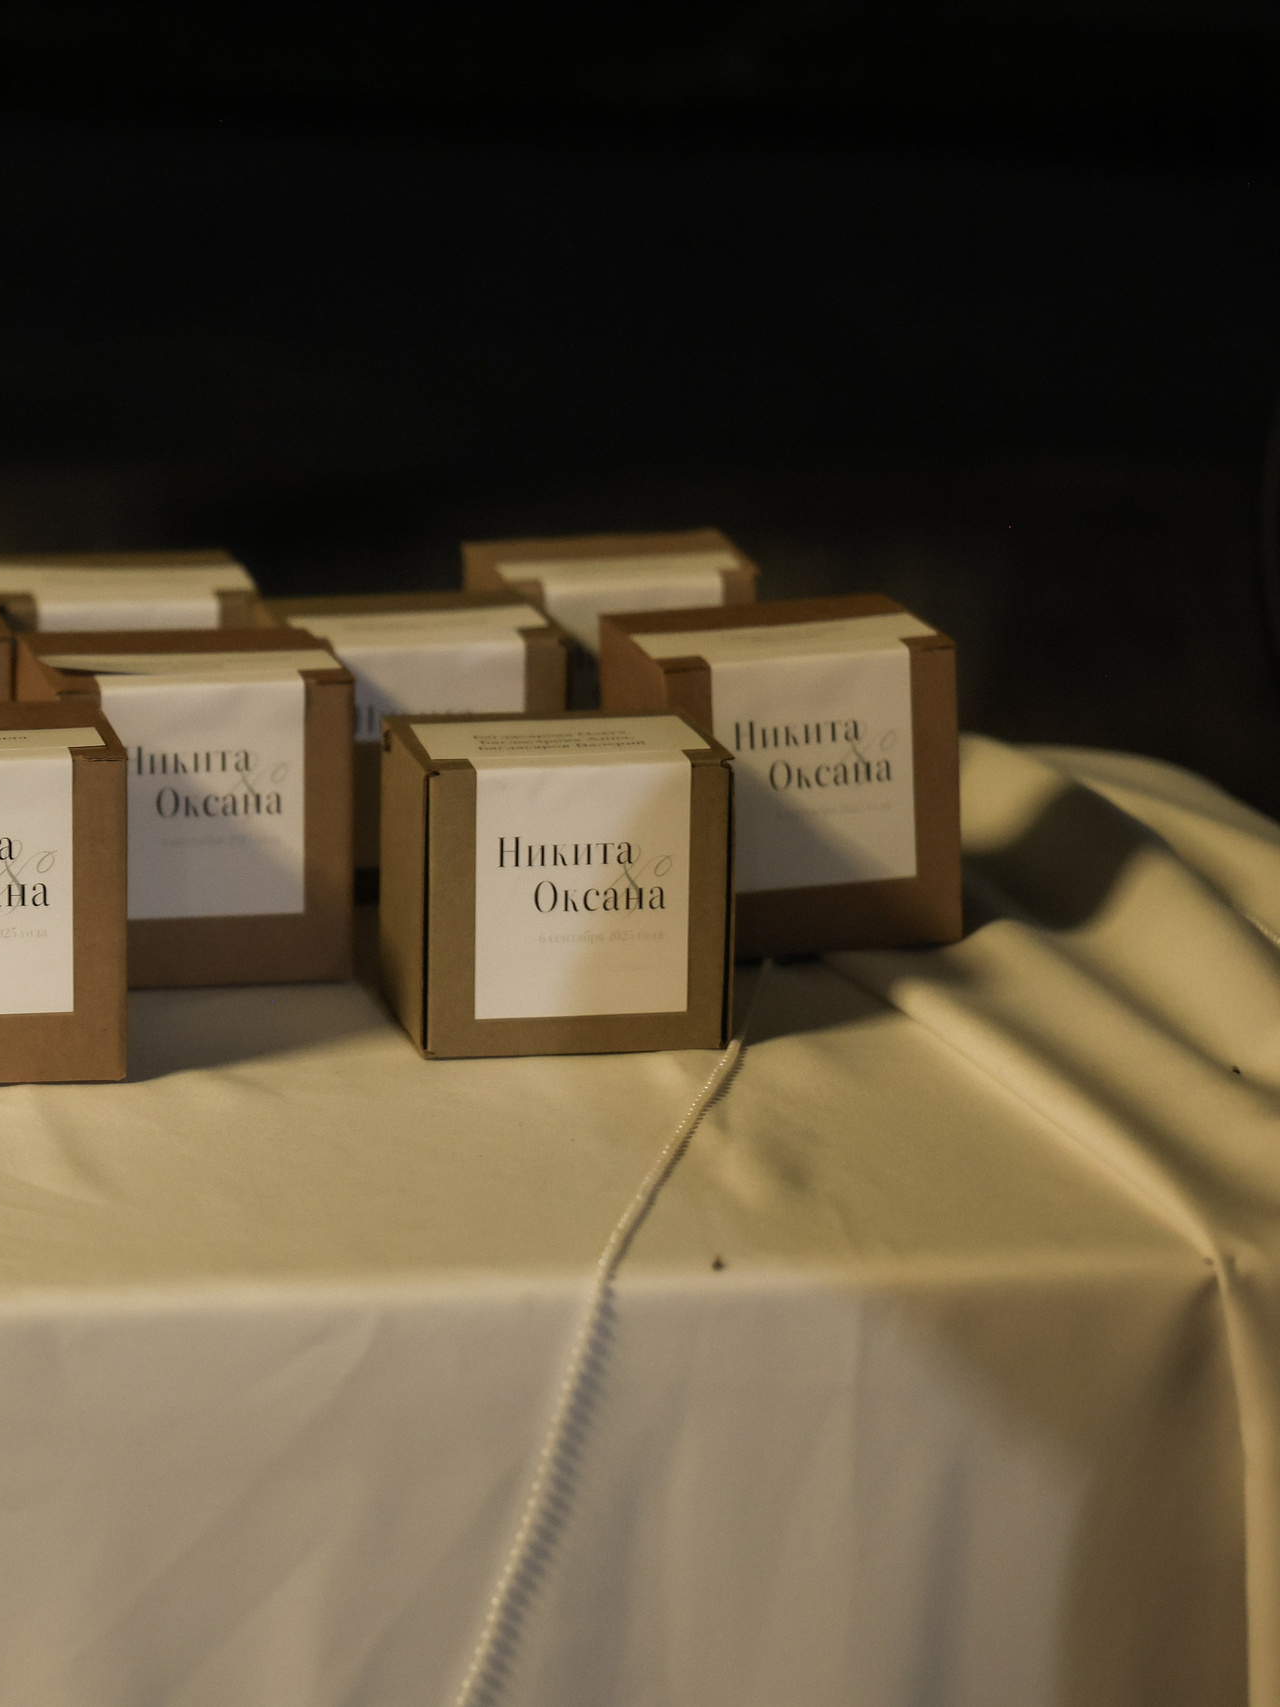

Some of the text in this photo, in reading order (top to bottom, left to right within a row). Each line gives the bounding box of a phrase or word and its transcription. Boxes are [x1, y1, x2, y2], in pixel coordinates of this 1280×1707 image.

[734, 719, 860, 751] Никита
[770, 758, 892, 791] Оксана
[156, 786, 282, 819] Оксана
[498, 836, 634, 868] Никита
[533, 880, 666, 913] Оксана
